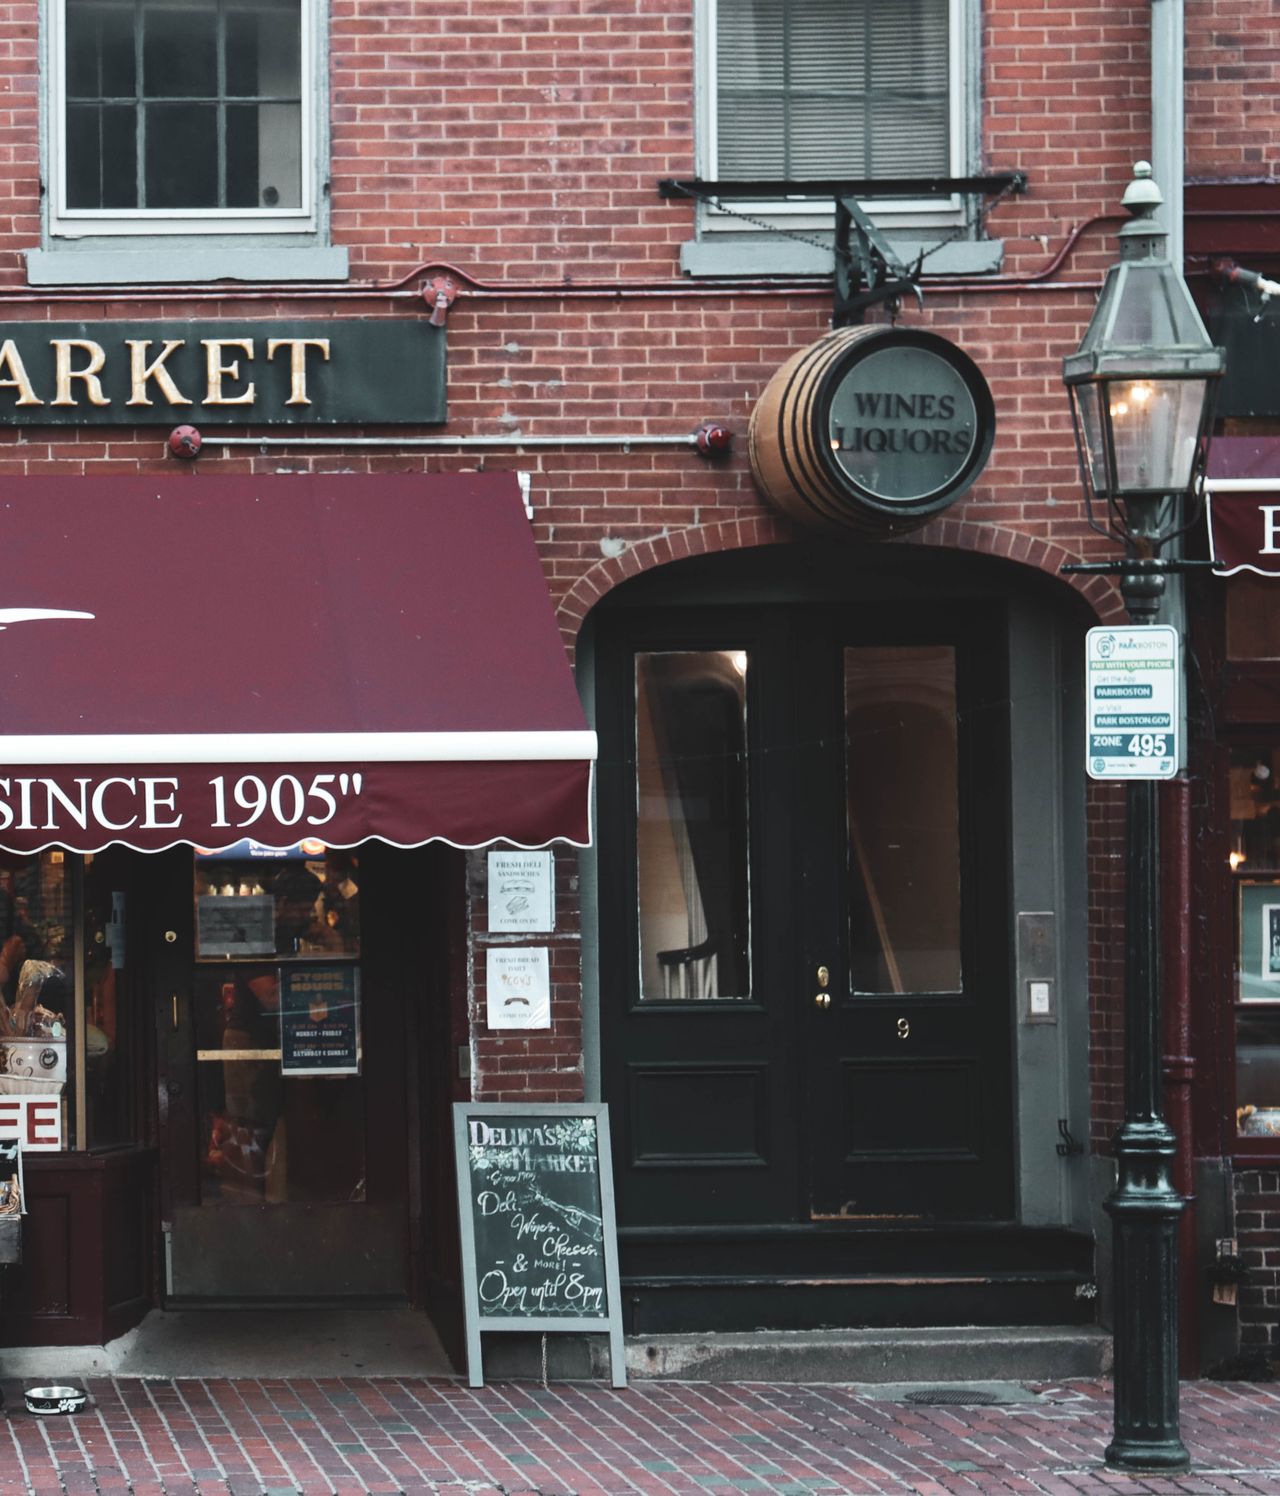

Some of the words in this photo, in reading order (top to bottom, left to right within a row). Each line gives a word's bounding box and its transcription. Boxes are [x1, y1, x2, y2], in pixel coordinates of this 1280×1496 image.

[853, 393, 955, 420] WINES
[834, 427, 970, 455] LIQUORS
[1106, 661, 1126, 669] WITH
[1147, 661, 1172, 669] PHONE
[1096, 687, 1151, 696] PARKBOSTON
[1093, 736, 1123, 747] ZONE
[1128, 735, 1167, 757] 495
[208, 772, 363, 829] 1905"
[495, 861, 521, 869] FRESH
[523, 861, 542, 869] DELI
[897, 1018, 910, 1039] 9
[511, 1146, 598, 1174] MARKET
[479, 1269, 528, 1311] Open
[531, 1272, 566, 1311] until
